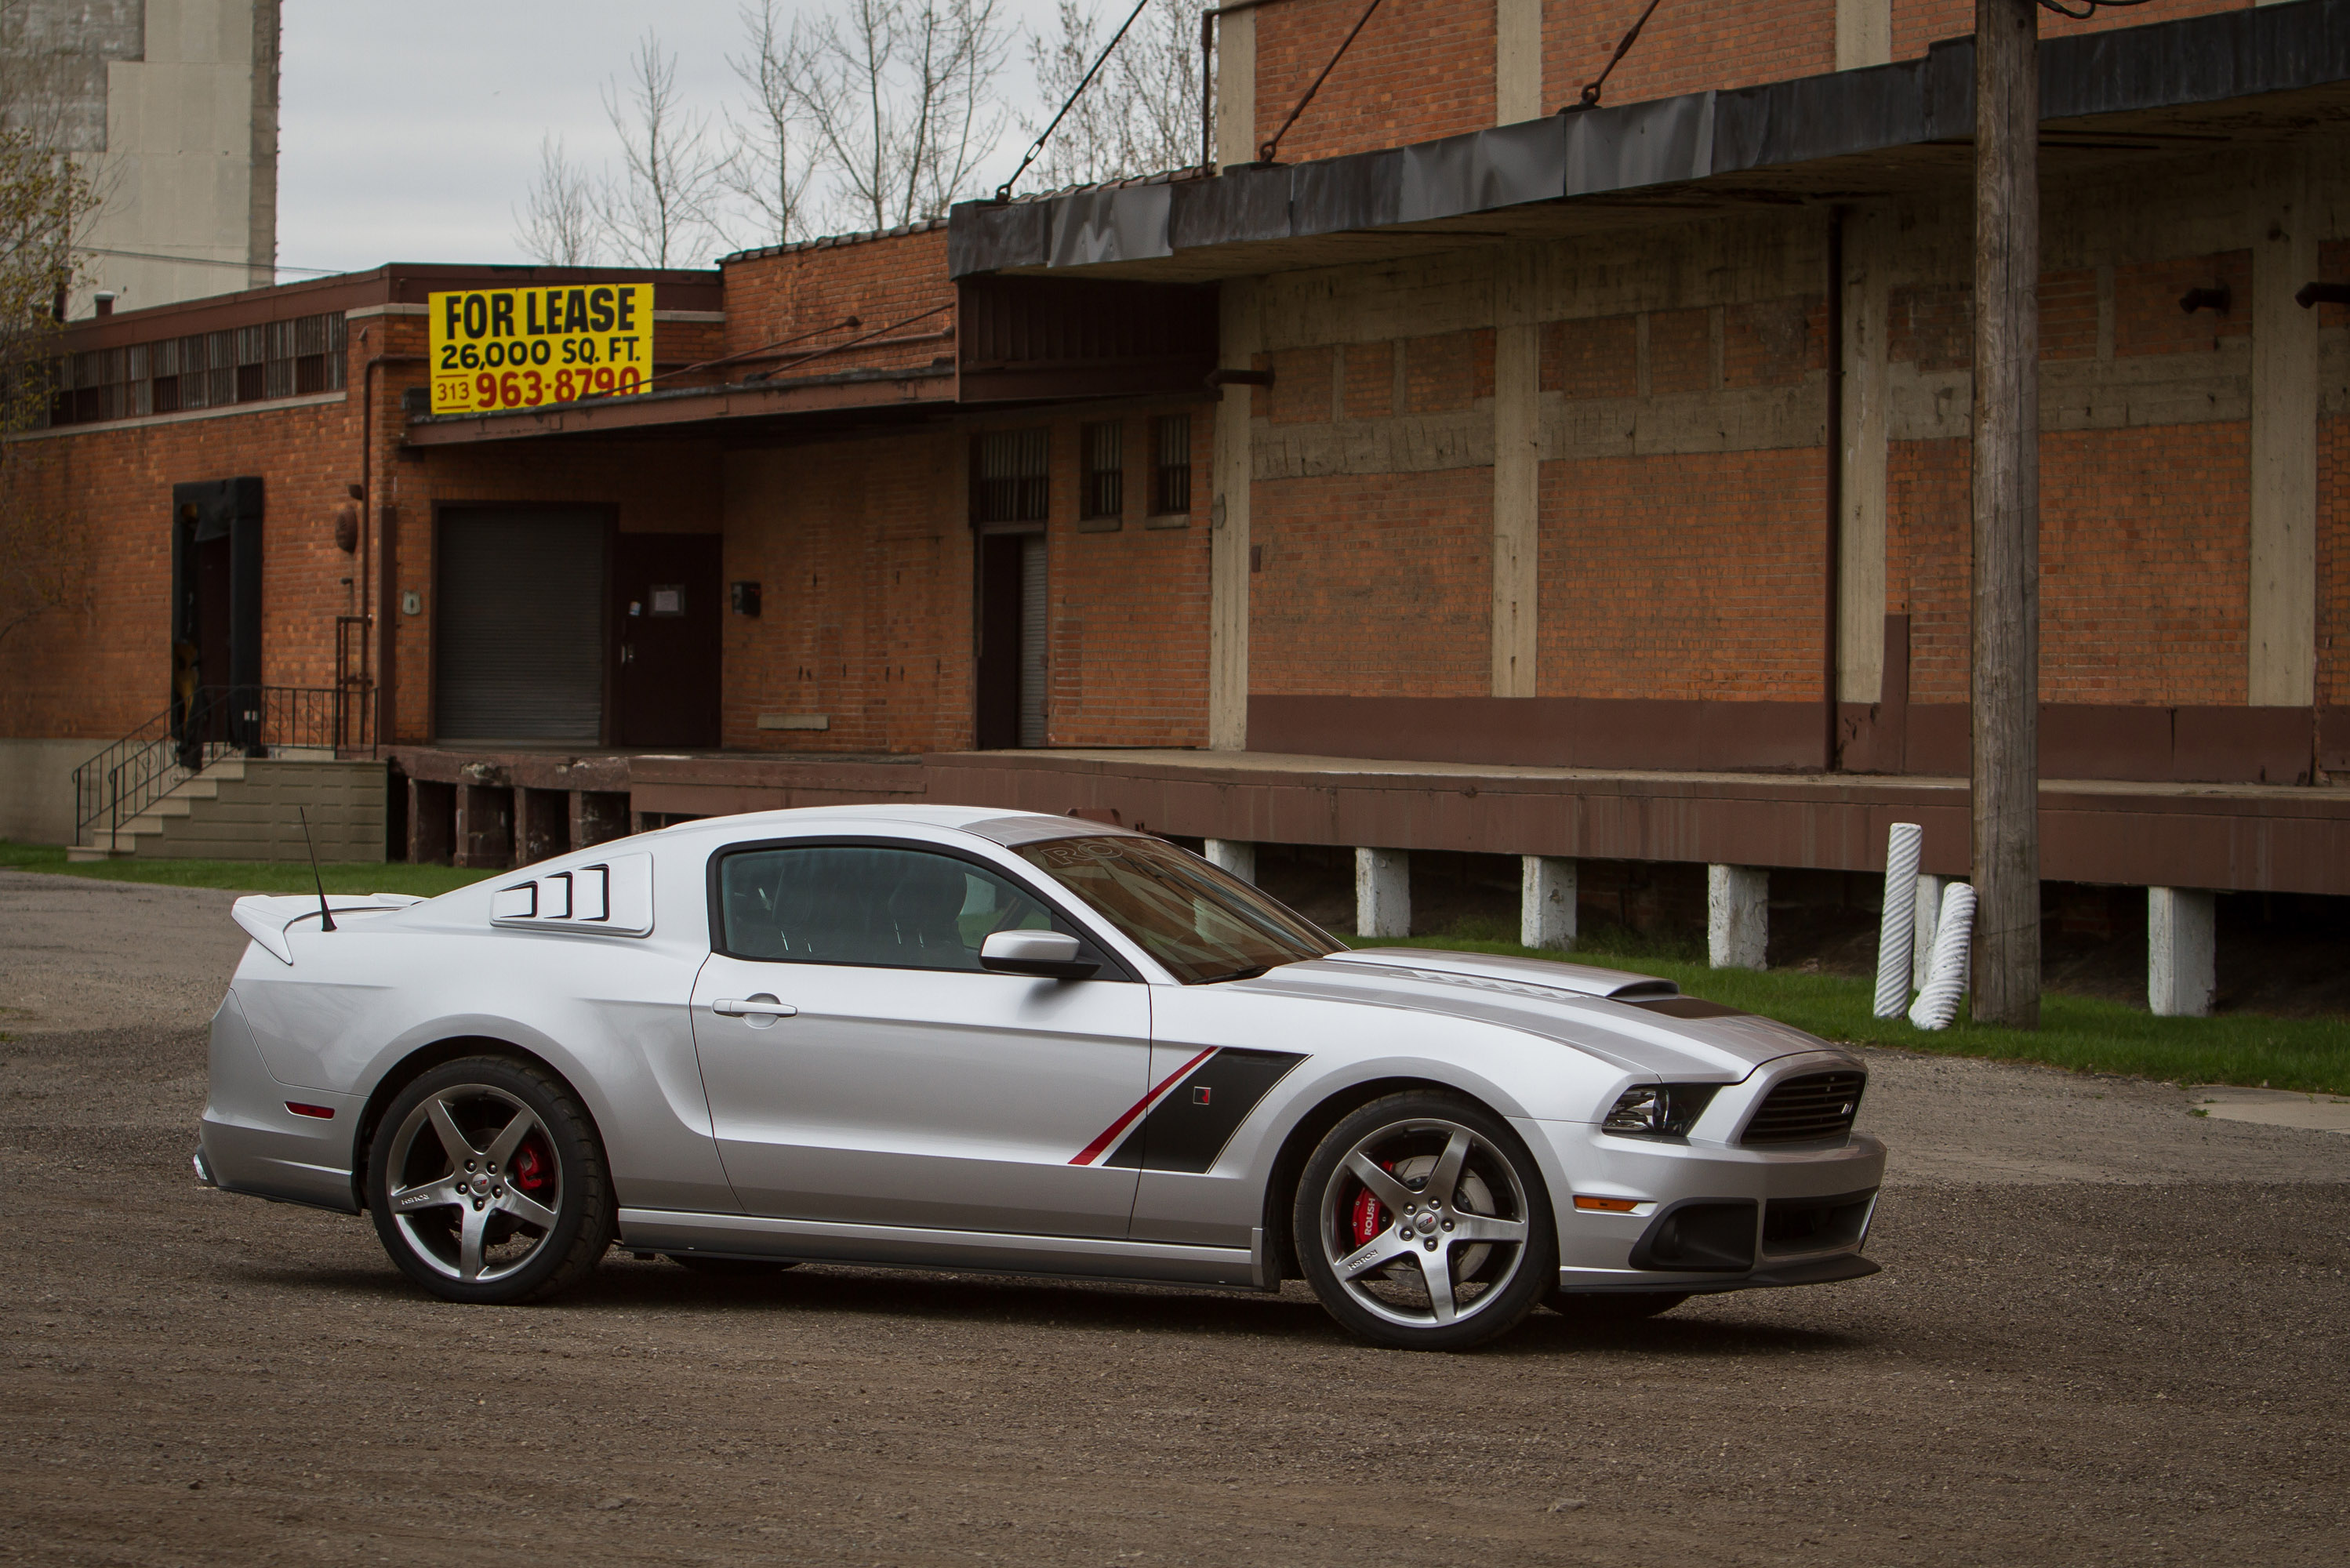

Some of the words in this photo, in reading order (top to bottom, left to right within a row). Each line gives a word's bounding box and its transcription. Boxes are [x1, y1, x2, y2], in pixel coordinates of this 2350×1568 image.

[445, 293, 516, 339] FOR
[526, 288, 636, 336] LEASE
[441, 339, 551, 371] 26,000
[561, 337, 601, 365] SQ.
[608, 336, 641, 361] FT.
[437, 381, 470, 401] 313
[475, 366, 641, 408] 963-8790
[1364, 1197, 1376, 1236] ROUSH
[1347, 1248, 1378, 1271] ROUSH
